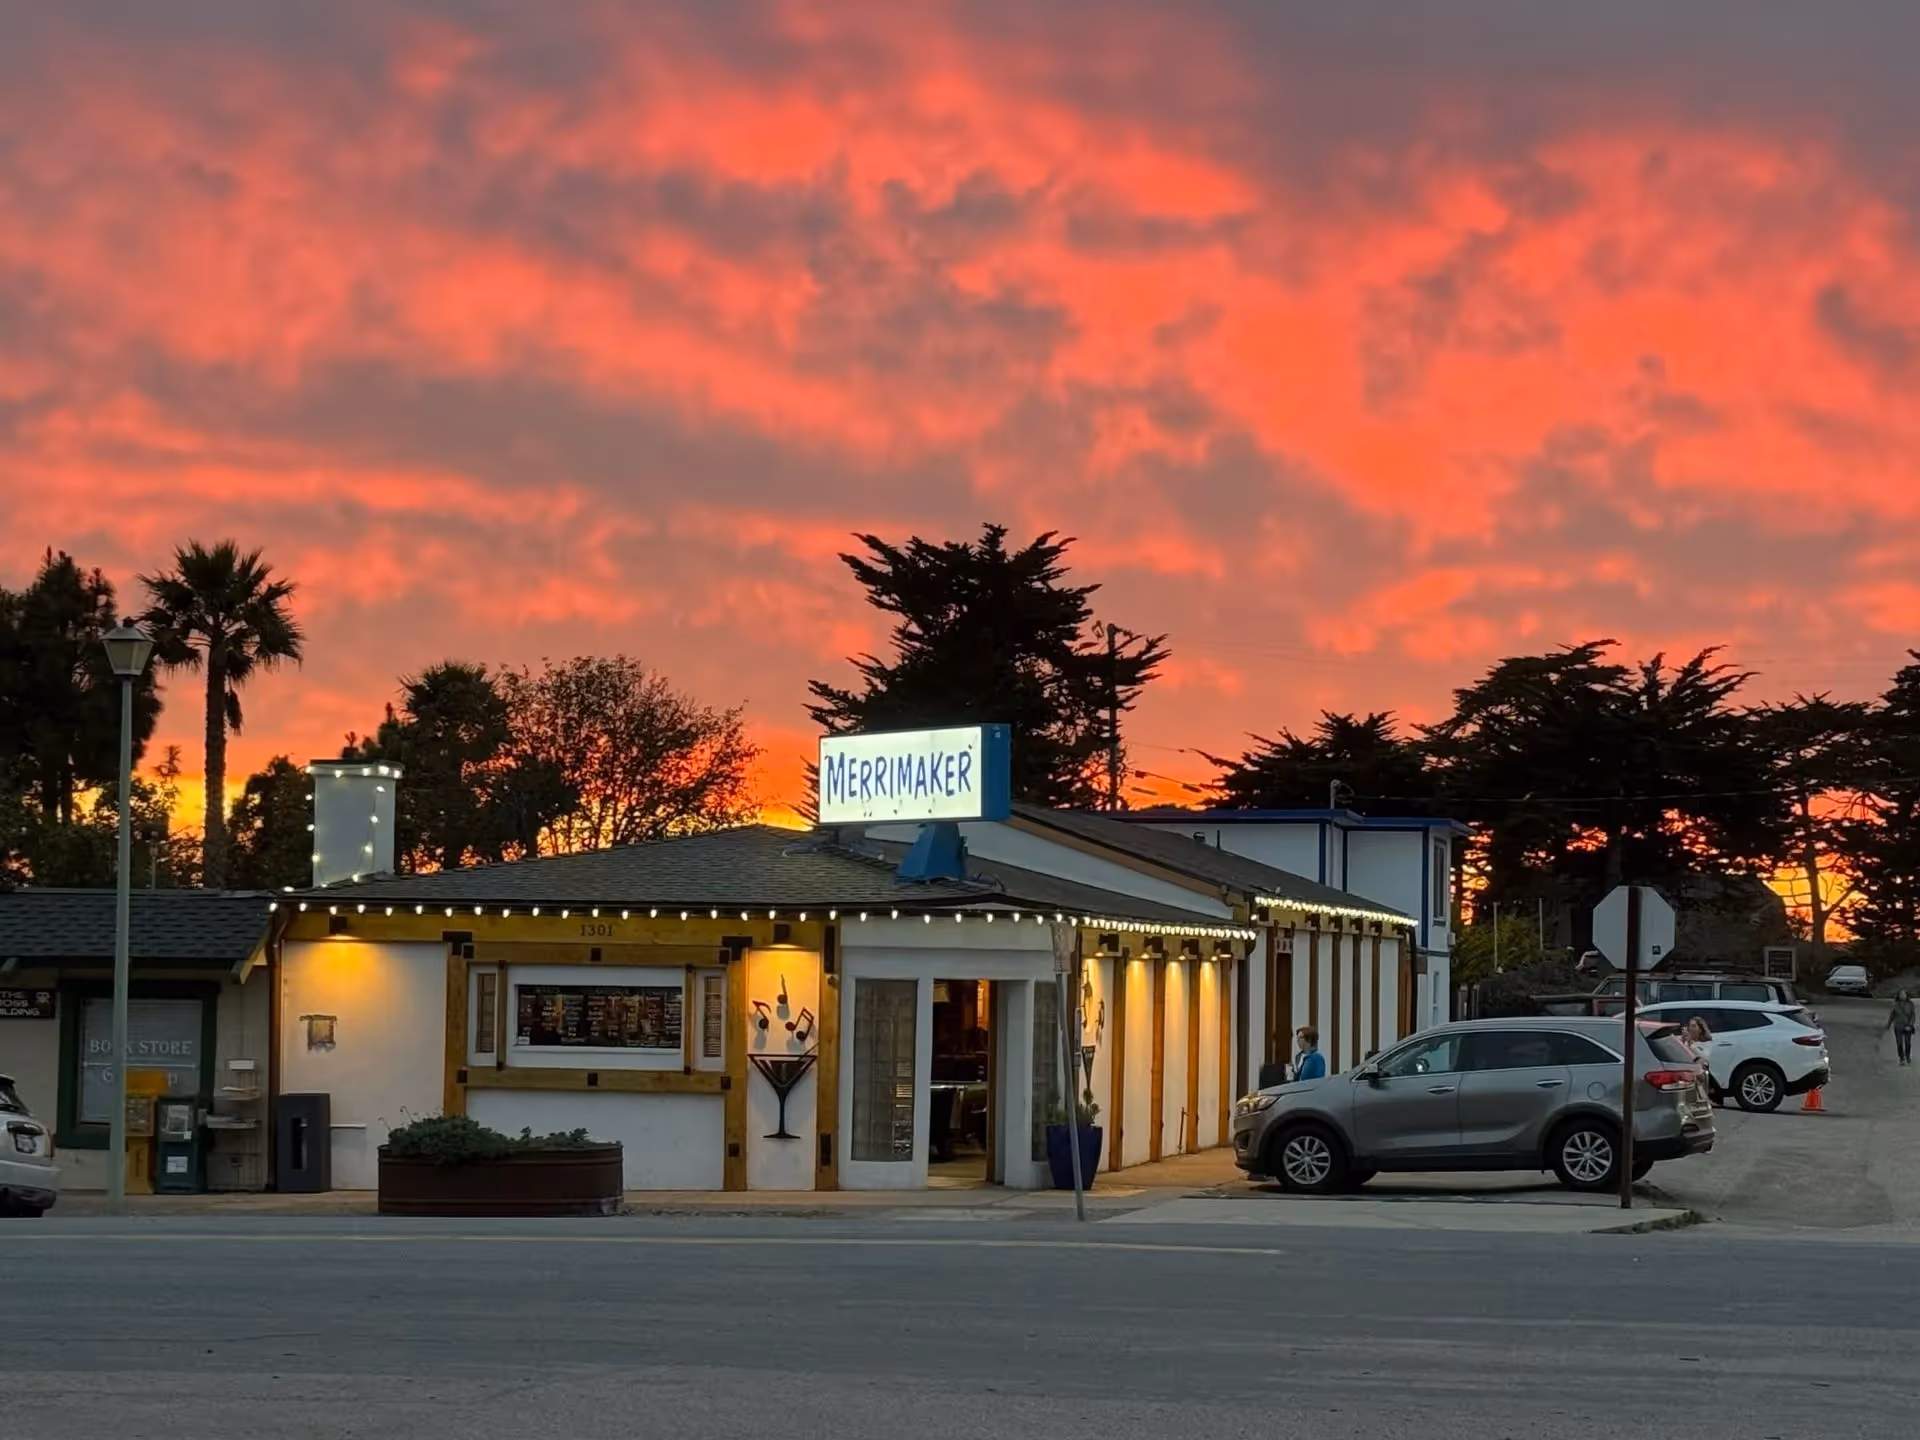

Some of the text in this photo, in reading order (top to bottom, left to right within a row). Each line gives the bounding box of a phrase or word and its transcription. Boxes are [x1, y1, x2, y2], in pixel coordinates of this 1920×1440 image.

[825, 750, 973, 804] MERRIMAKER
[581, 924, 613, 937] 1301
[139, 1040, 193, 1055] STORE
